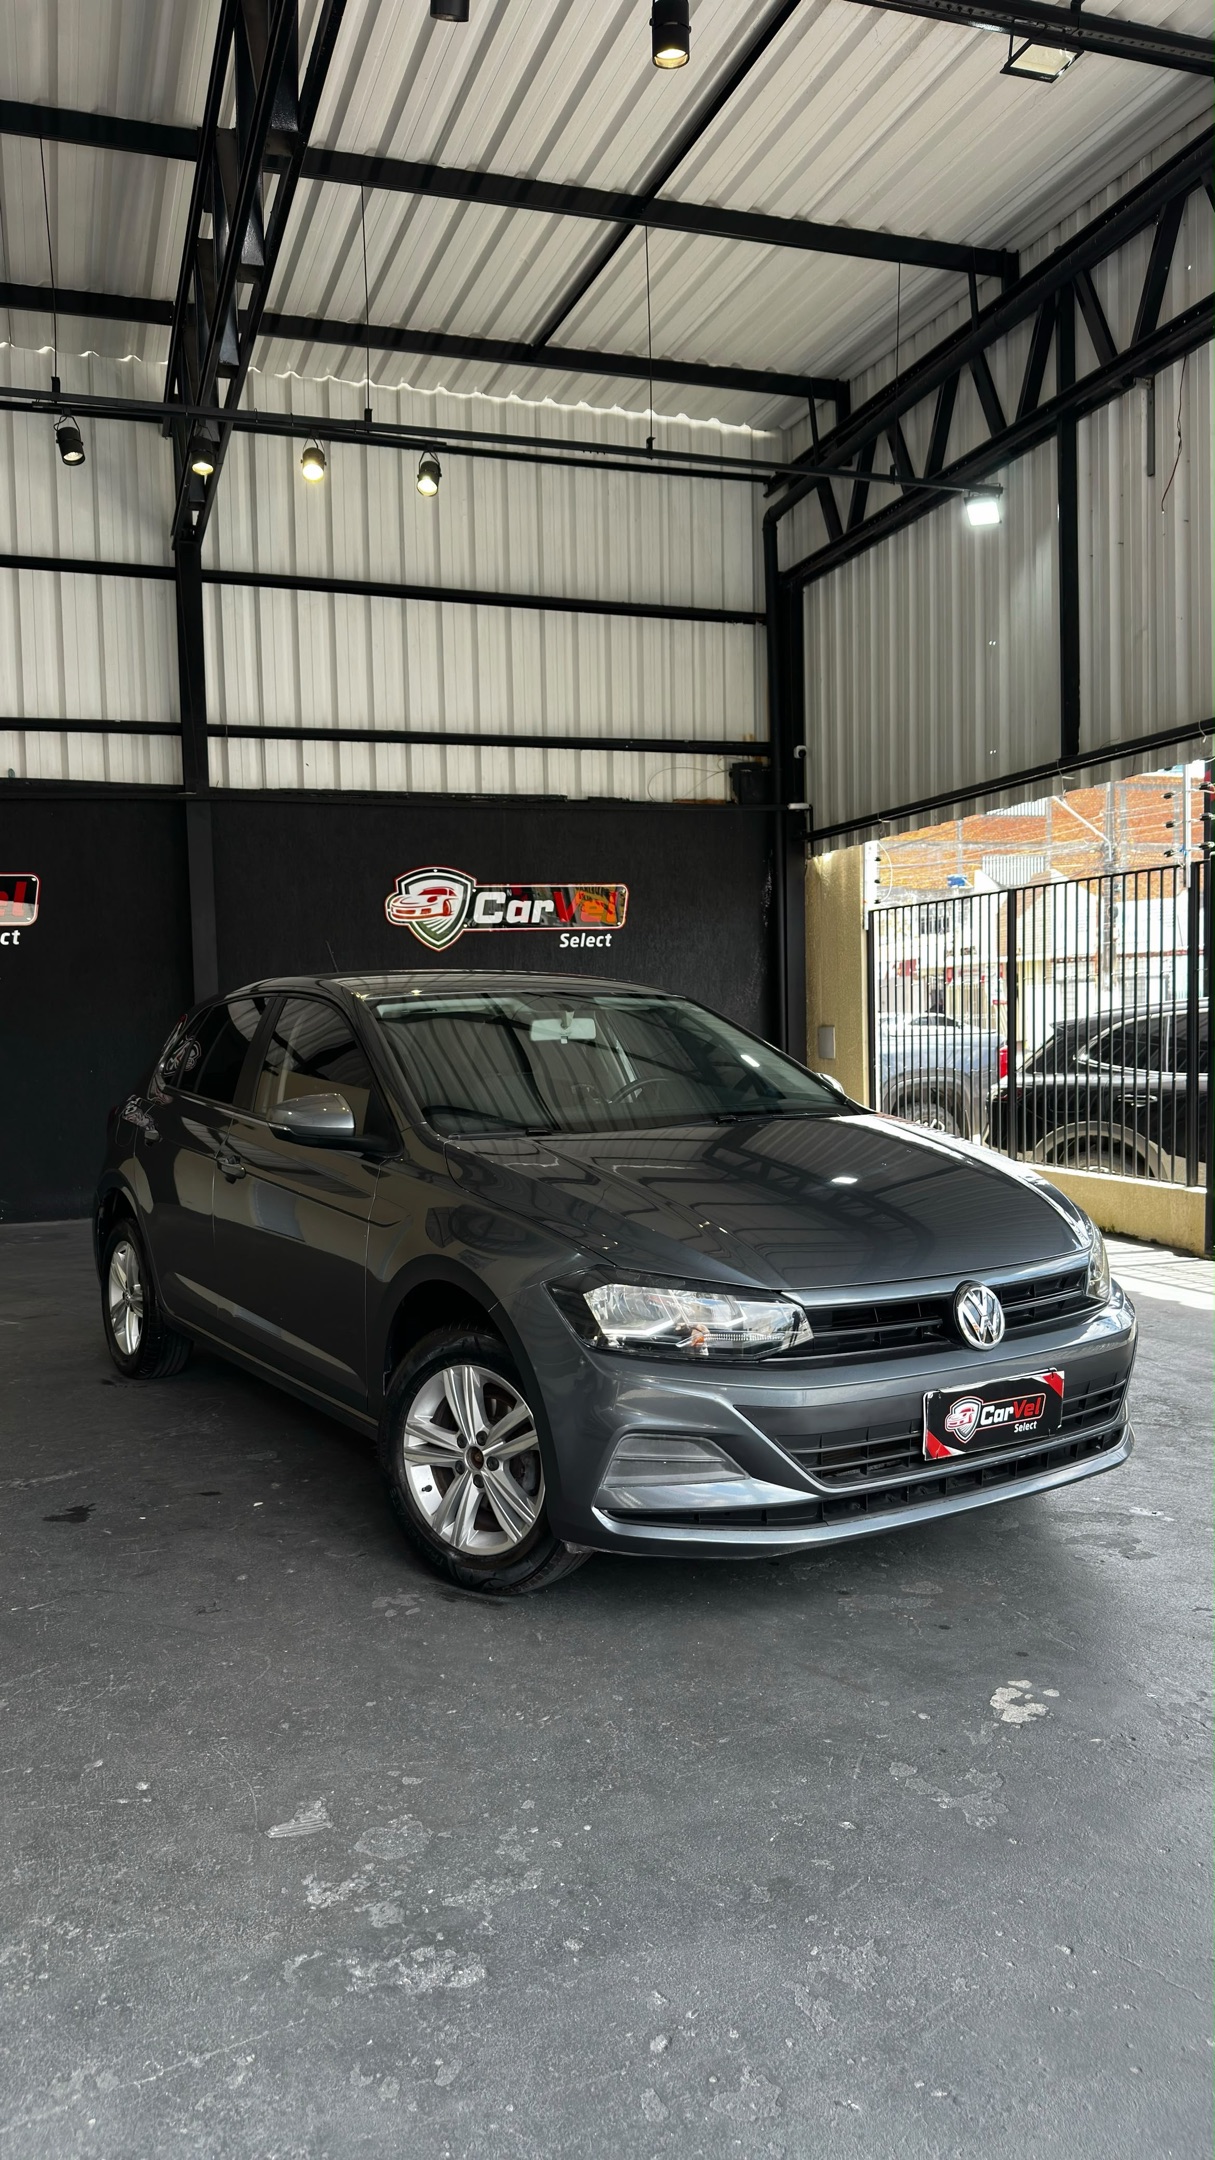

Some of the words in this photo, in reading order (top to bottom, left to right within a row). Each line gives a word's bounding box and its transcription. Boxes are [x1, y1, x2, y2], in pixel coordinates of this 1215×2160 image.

[473, 891, 619, 924] CarVel
[559, 932, 613, 948] Select
[980, 1397, 1042, 1426] CarVel
[1013, 1420, 1038, 1433] Select
